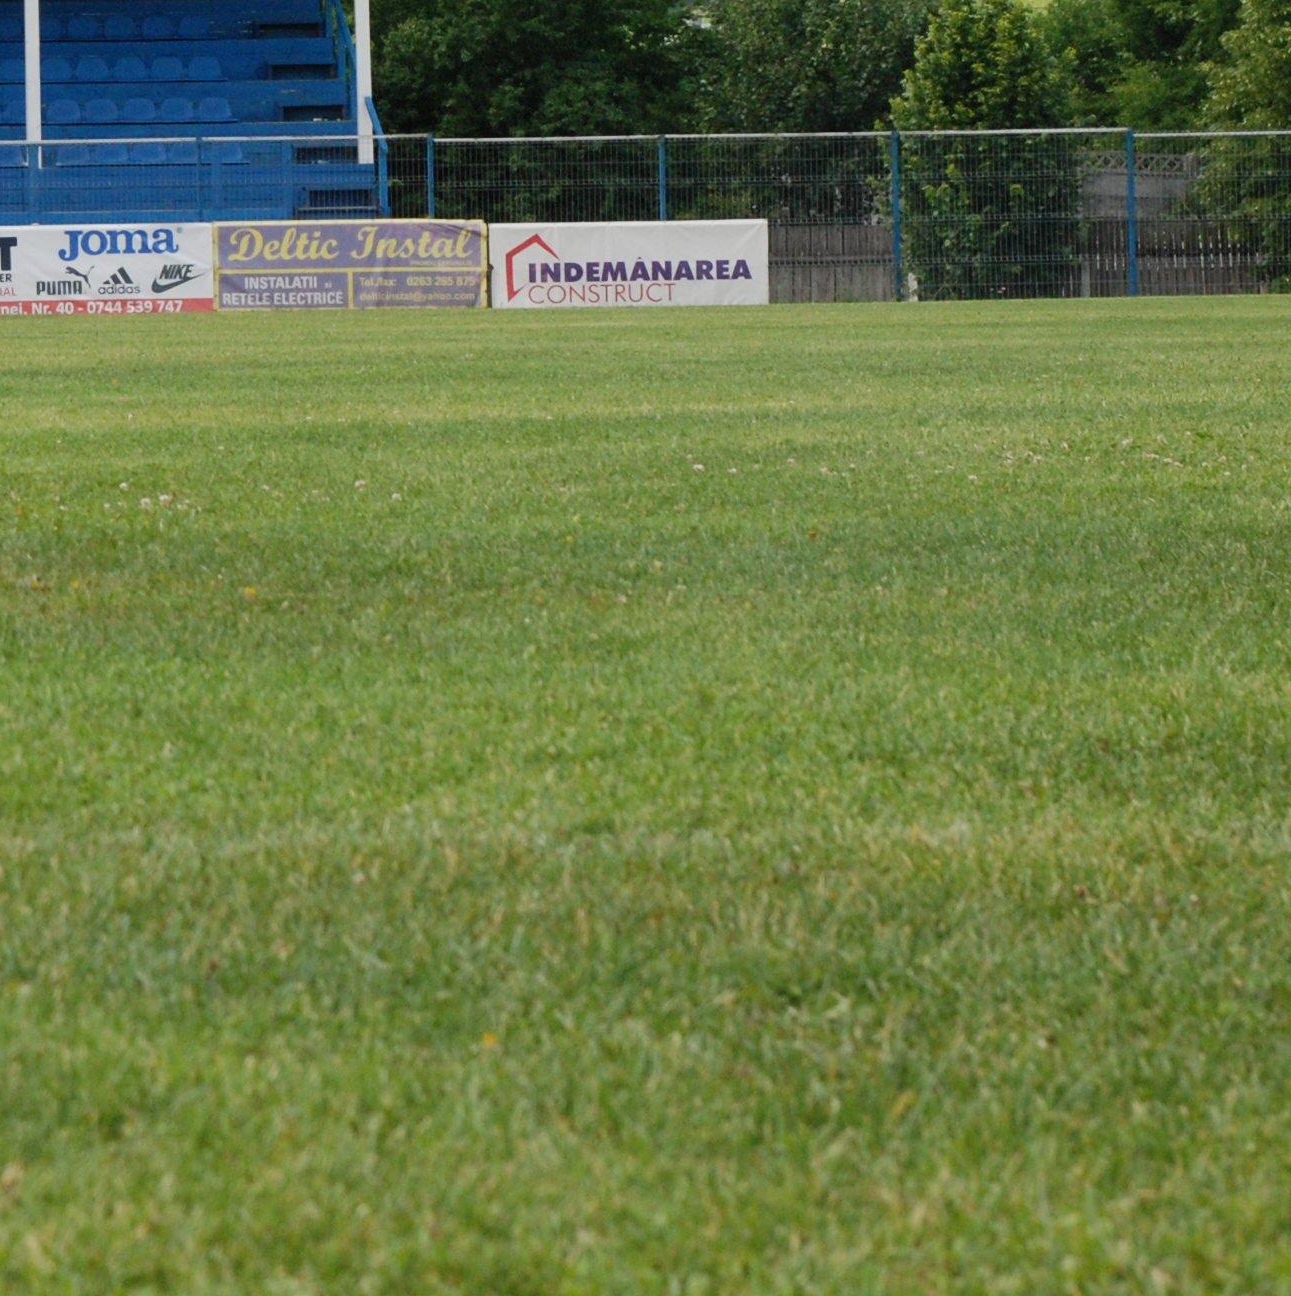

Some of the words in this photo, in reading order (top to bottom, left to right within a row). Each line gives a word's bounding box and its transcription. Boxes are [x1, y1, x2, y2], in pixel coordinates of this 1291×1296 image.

[227, 227, 340, 262] Deltic
[350, 226, 473, 260] Instal
[159, 264, 195, 279] NIKE
[528, 257, 752, 284] INDEMÂNAREA
[36, 280, 83, 295] PUMA
[244, 275, 317, 290] INSTALATII
[406, 275, 433, 286] 0263
[98, 283, 141, 295] adidas
[528, 282, 676, 304] CONSTRUCT
[222, 292, 271, 306] RETELE
[273, 292, 344, 306] ELECTRICE
[32, 302, 53, 315] Nr.
[56, 302, 74, 315] 40
[86, 301, 123, 313] 0744
[126, 300, 153, 313] 539
[156, 300, 183, 313] 747
